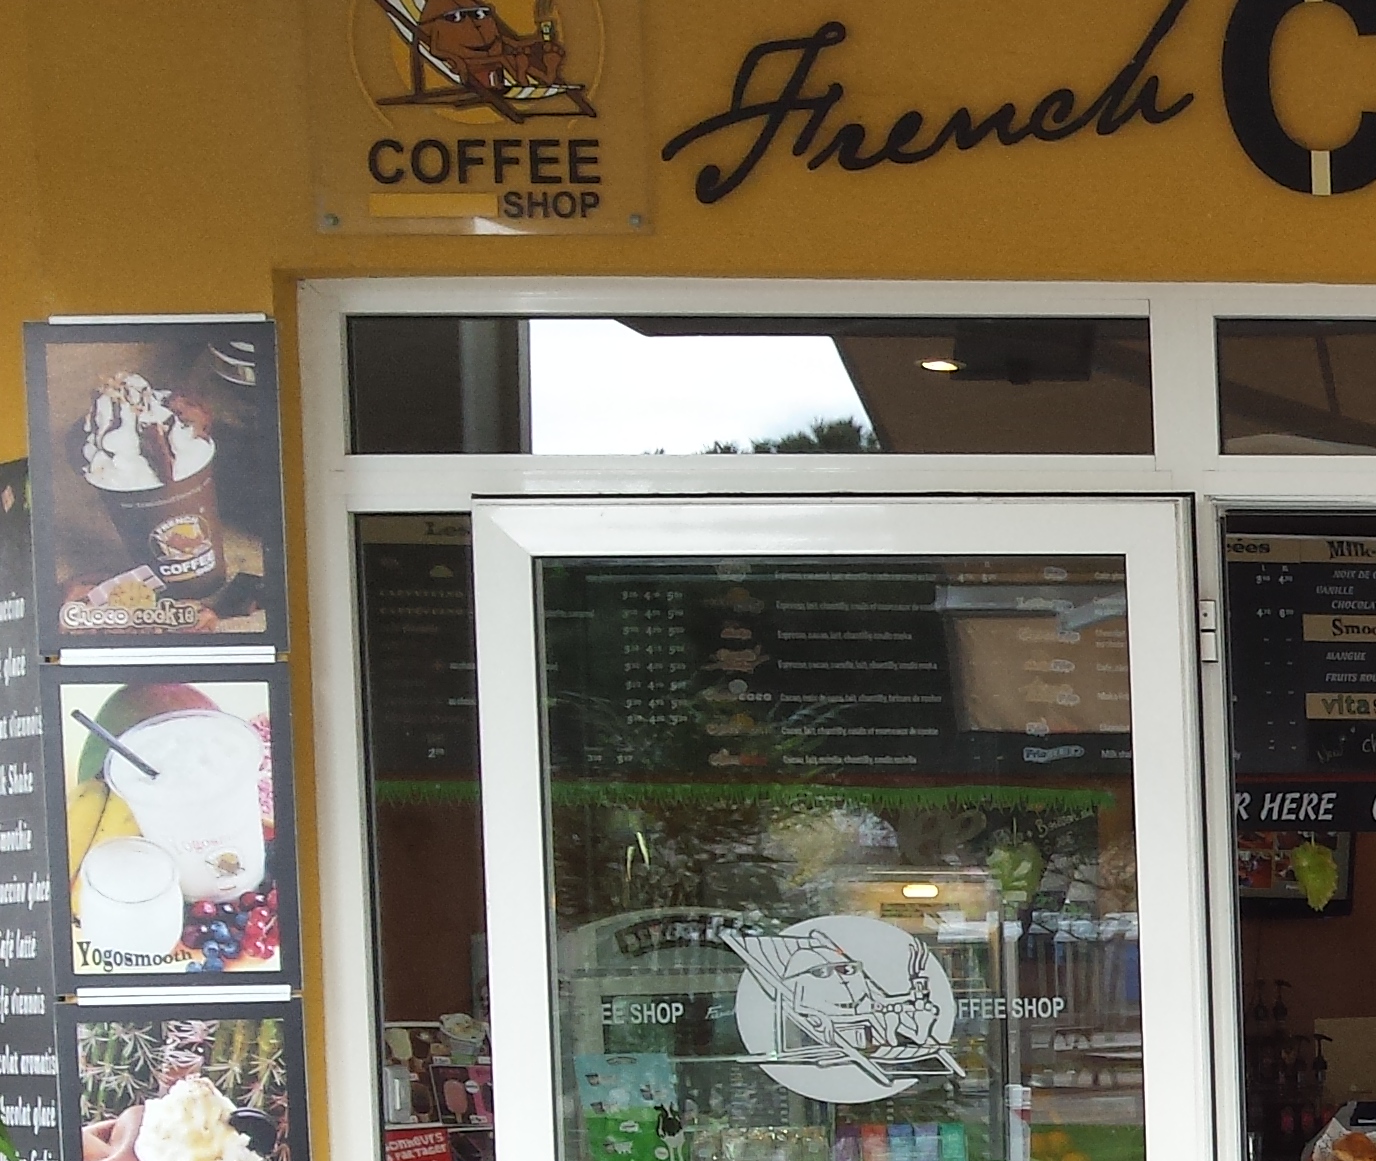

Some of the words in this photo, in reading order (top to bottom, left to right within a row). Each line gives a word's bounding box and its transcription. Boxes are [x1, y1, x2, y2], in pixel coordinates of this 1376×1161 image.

[661, 0, 1196, 206] French
[367, 138, 601, 186] COFFEE
[502, 190, 600, 220] SHOP
[1358, 570, 1371, 580] DE
[1325, 672, 1358, 683] FRUITS
[1260, 792, 1338, 822] HERE
[75, 939, 195, 972] Yogosmooth
[630, 1002, 685, 1024] SHOP
[1011, 997, 1065, 1019] SHOP
